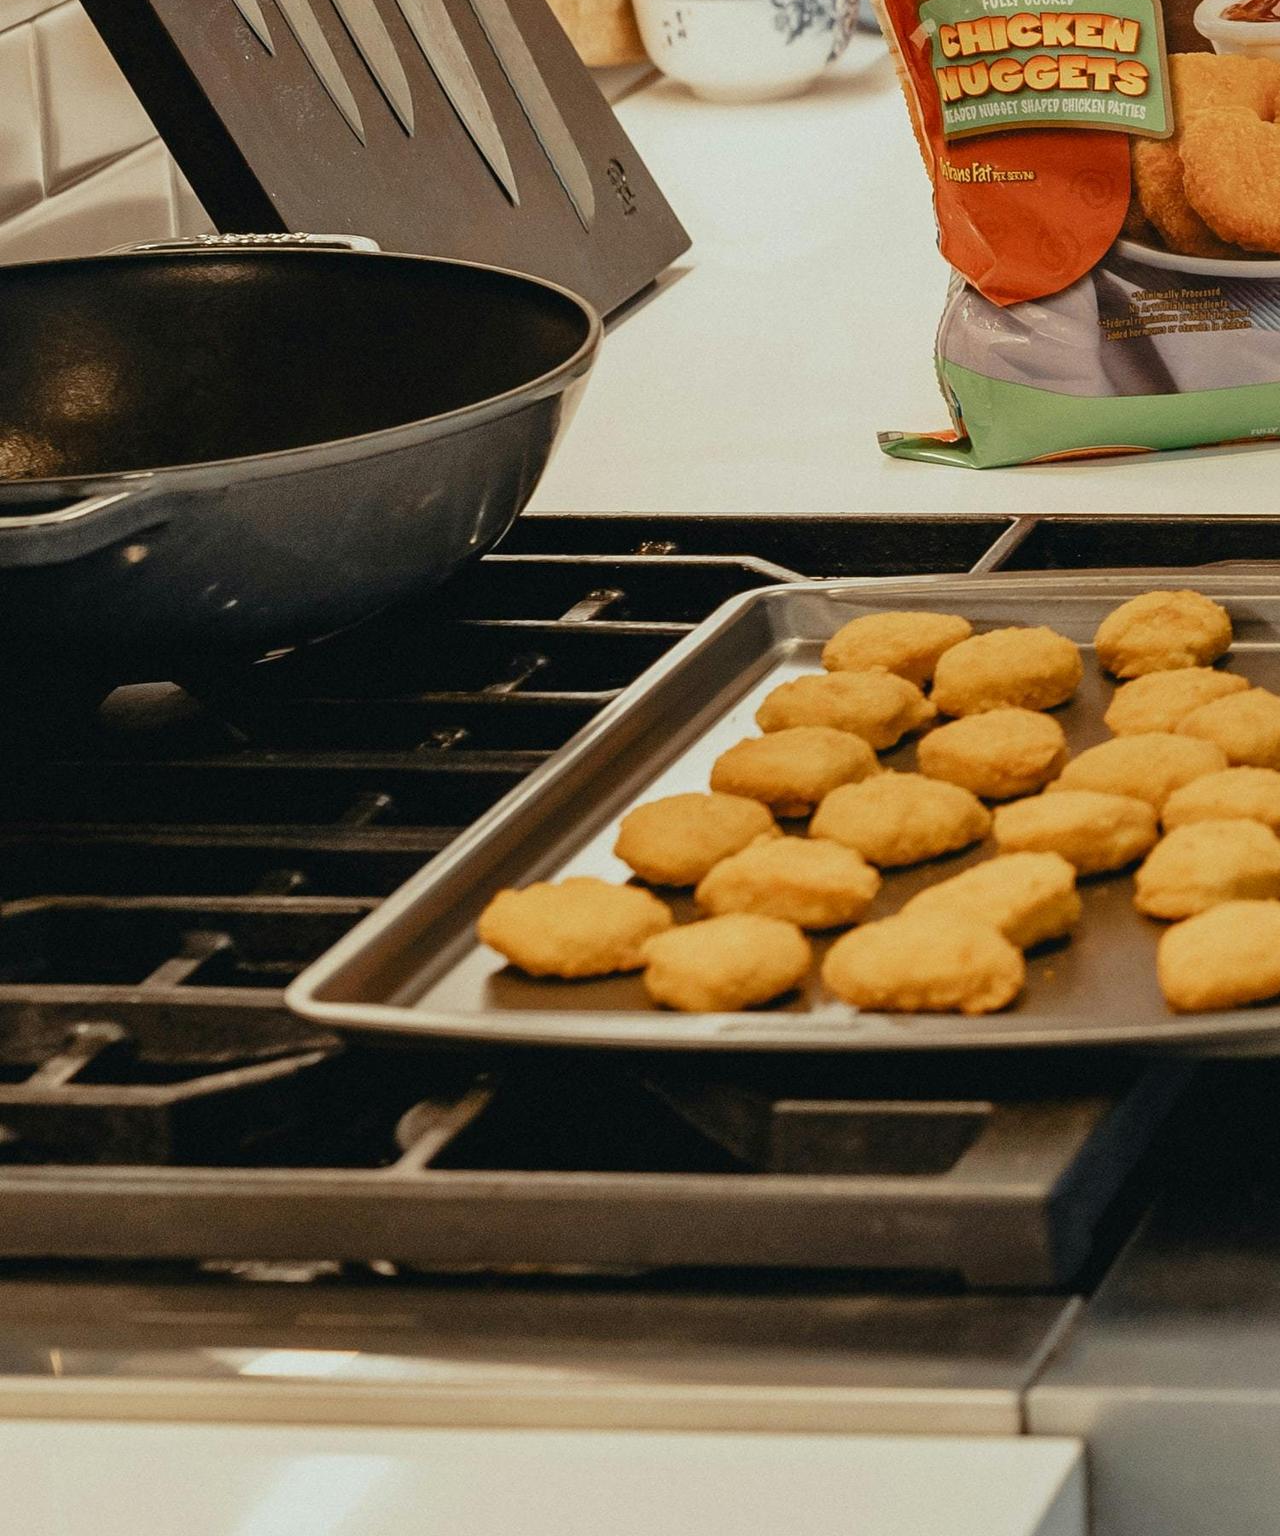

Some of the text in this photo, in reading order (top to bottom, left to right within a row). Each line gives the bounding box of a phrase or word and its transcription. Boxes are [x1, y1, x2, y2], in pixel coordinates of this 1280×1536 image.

[938, 11, 1141, 59] CHICKEN
[936, 54, 1149, 101] NUGGETS
[979, 100, 1019, 119] NUGGET
[1021, 98, 1059, 114] SHAPED
[1062, 98, 1105, 114] CHICKEN
[1107, 102, 1147, 121] PATTIES
[972, 162, 992, 182] Fat
